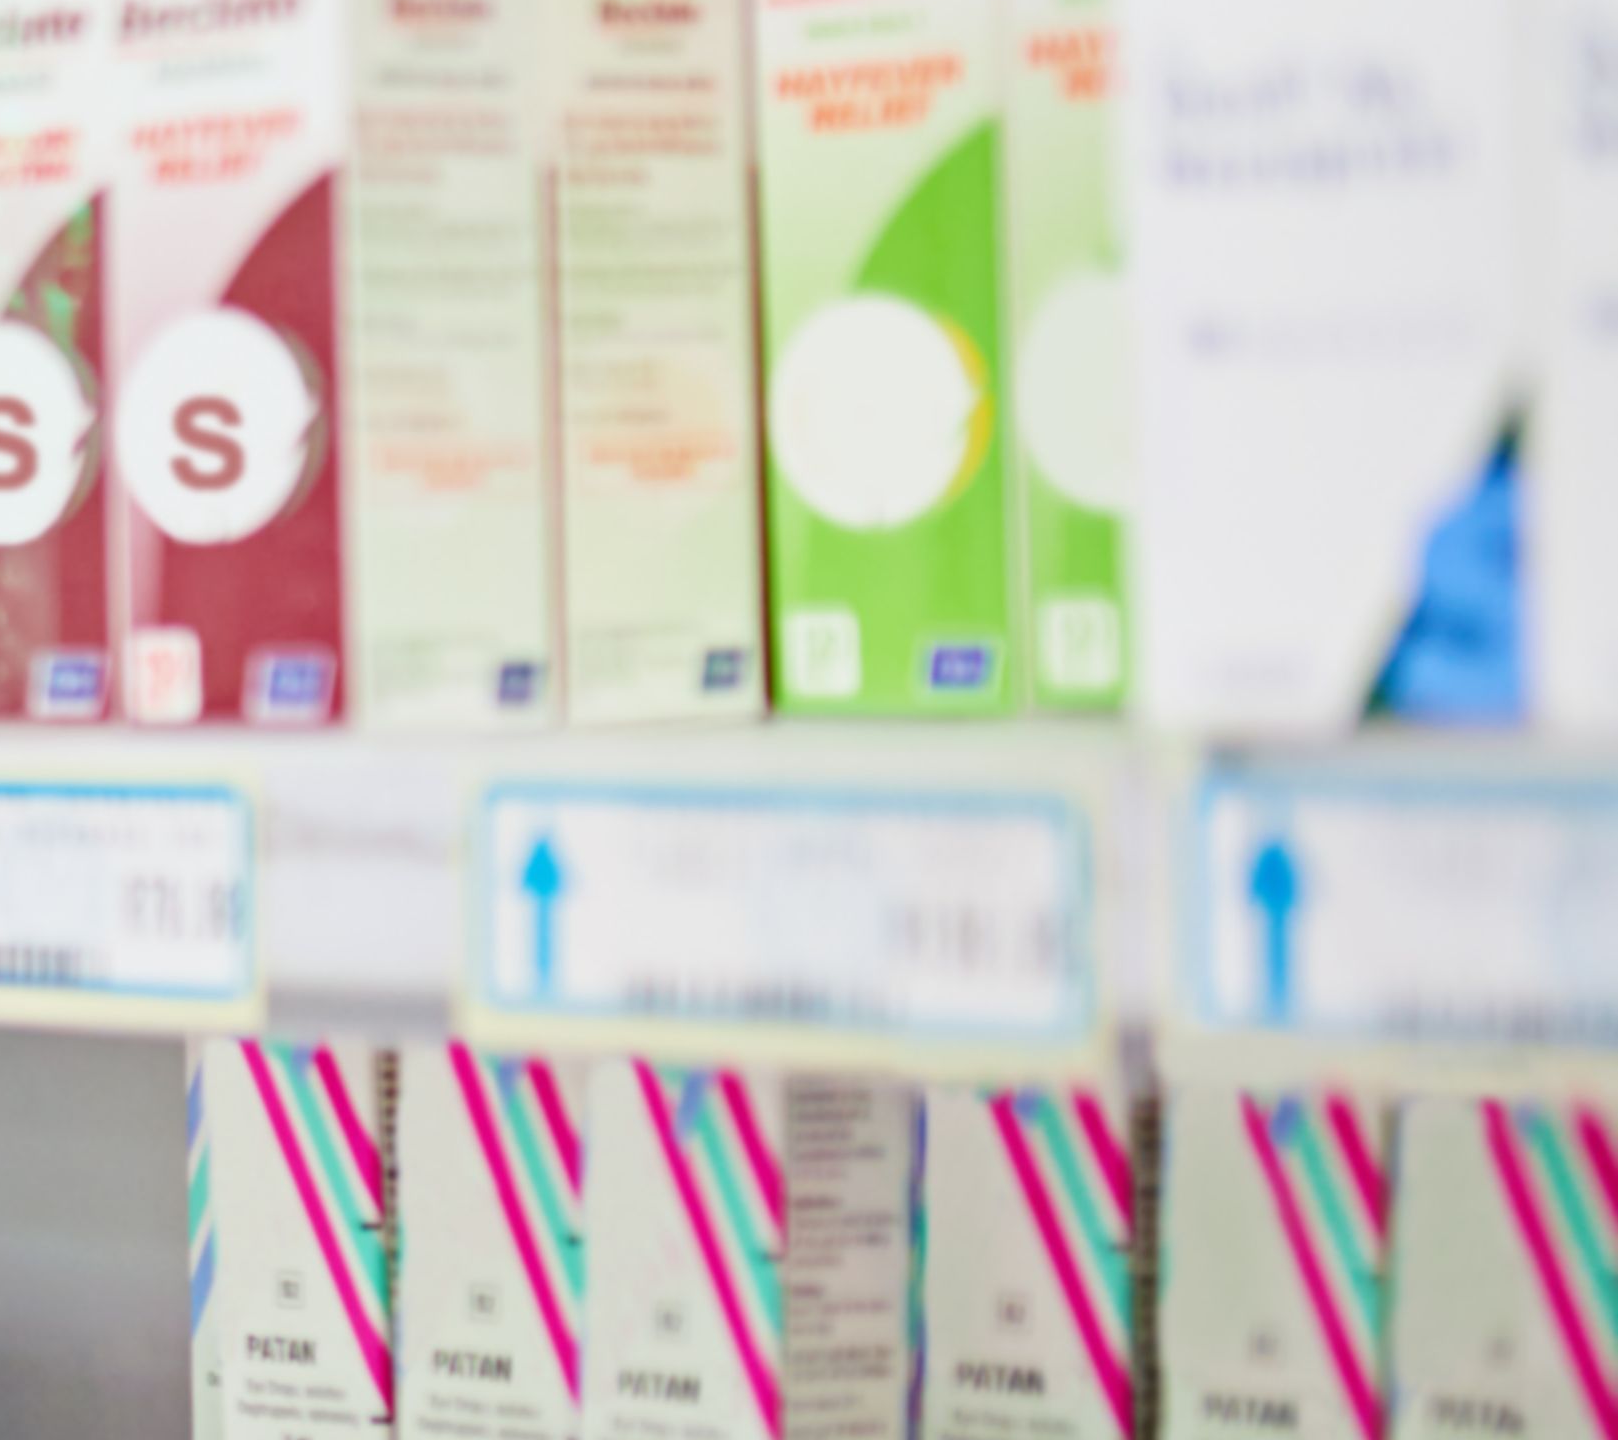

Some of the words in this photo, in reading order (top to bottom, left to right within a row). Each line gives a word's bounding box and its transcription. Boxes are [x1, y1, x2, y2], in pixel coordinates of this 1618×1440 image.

[170, 393, 246, 492] S
[246, 1333, 316, 1365] PATAN
[433, 1349, 513, 1382] PATAN
[618, 1370, 701, 1404] PATAN
